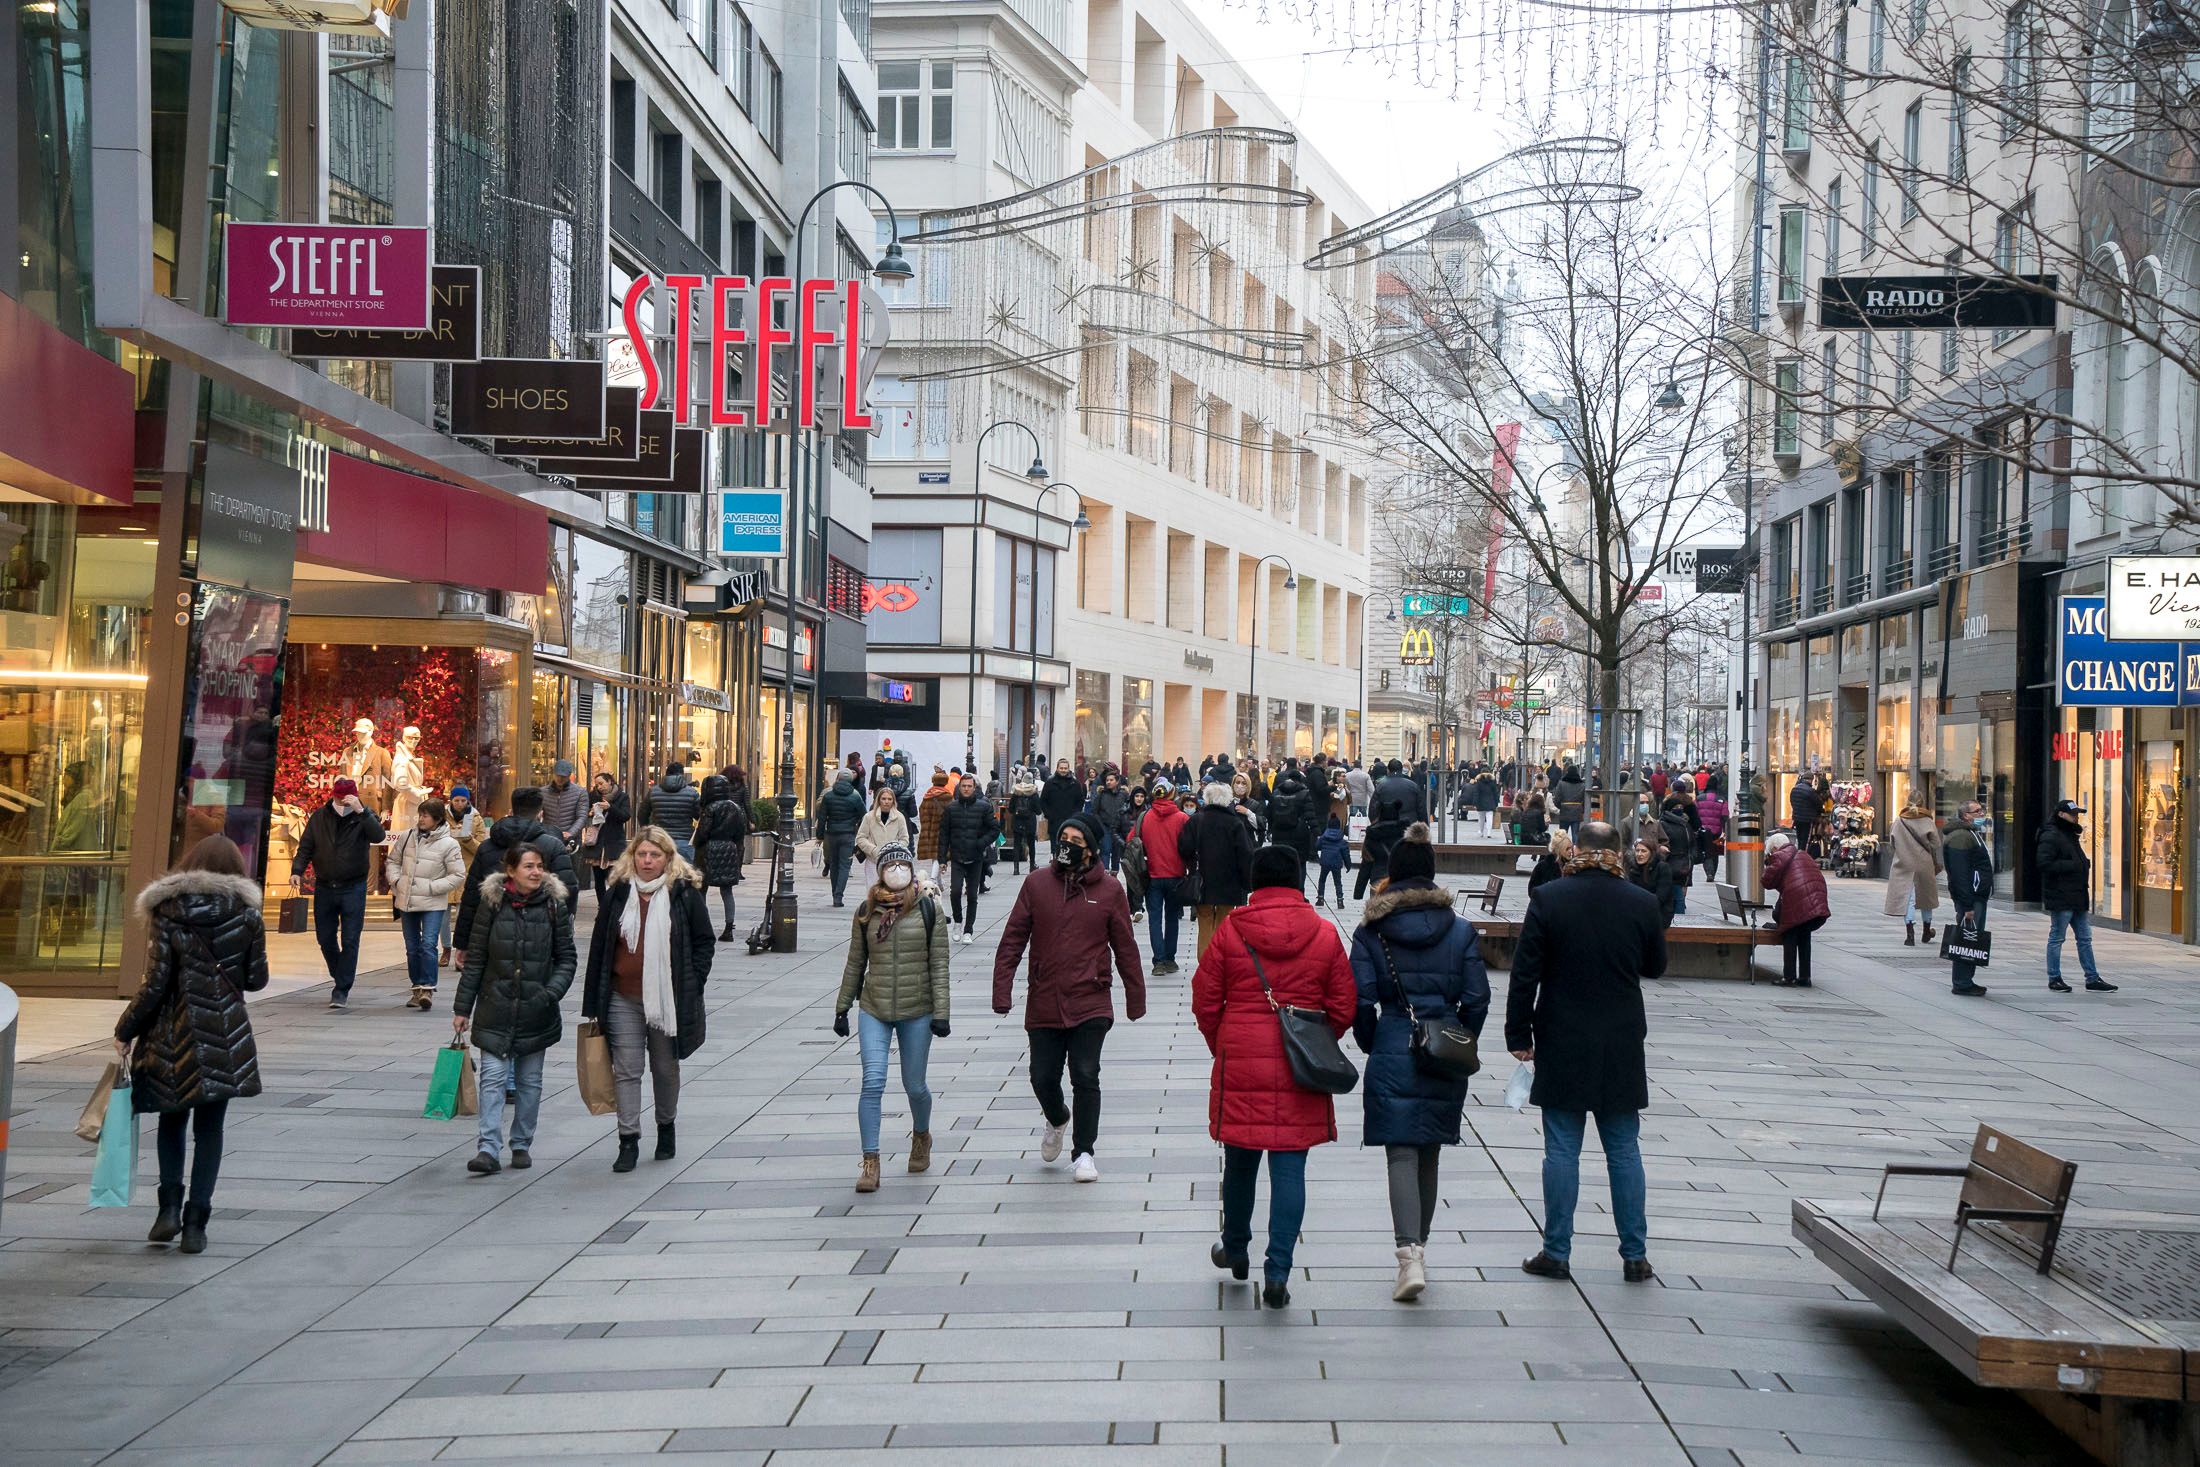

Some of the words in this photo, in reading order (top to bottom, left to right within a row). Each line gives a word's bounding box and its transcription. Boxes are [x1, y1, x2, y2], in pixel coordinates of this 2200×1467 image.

[269, 298, 289, 308] THE
[290, 299, 353, 309] DEPARTMENT
[354, 300, 385, 310] STORE
[1866, 290, 1944, 307] RADO
[622, 273, 873, 429] STEFFL
[486, 387, 569, 411] SHOES
[210, 492, 225, 514] THE
[226, 497, 271, 525] DEPARTMENT
[271, 510, 293, 532] STORE
[723, 513, 779, 523] AMERICAN
[238, 529, 263, 544] VIENNA
[734, 525, 782, 535] EXPRESS
[1702, 564, 1732, 574] BOS
[2127, 572, 2151, 588] E.
[730, 572, 755, 607] SIR
[1963, 614, 1988, 640] RADO
[203, 669, 258, 699] SHOPPING
[2065, 660, 2175, 692] CHANGE
[1851, 722, 1865, 778] IENNA
[2052, 732, 2077, 761] SALE
[2096, 729, 2122, 760] SALE
[1948, 944, 1988, 960] HUMANIC
